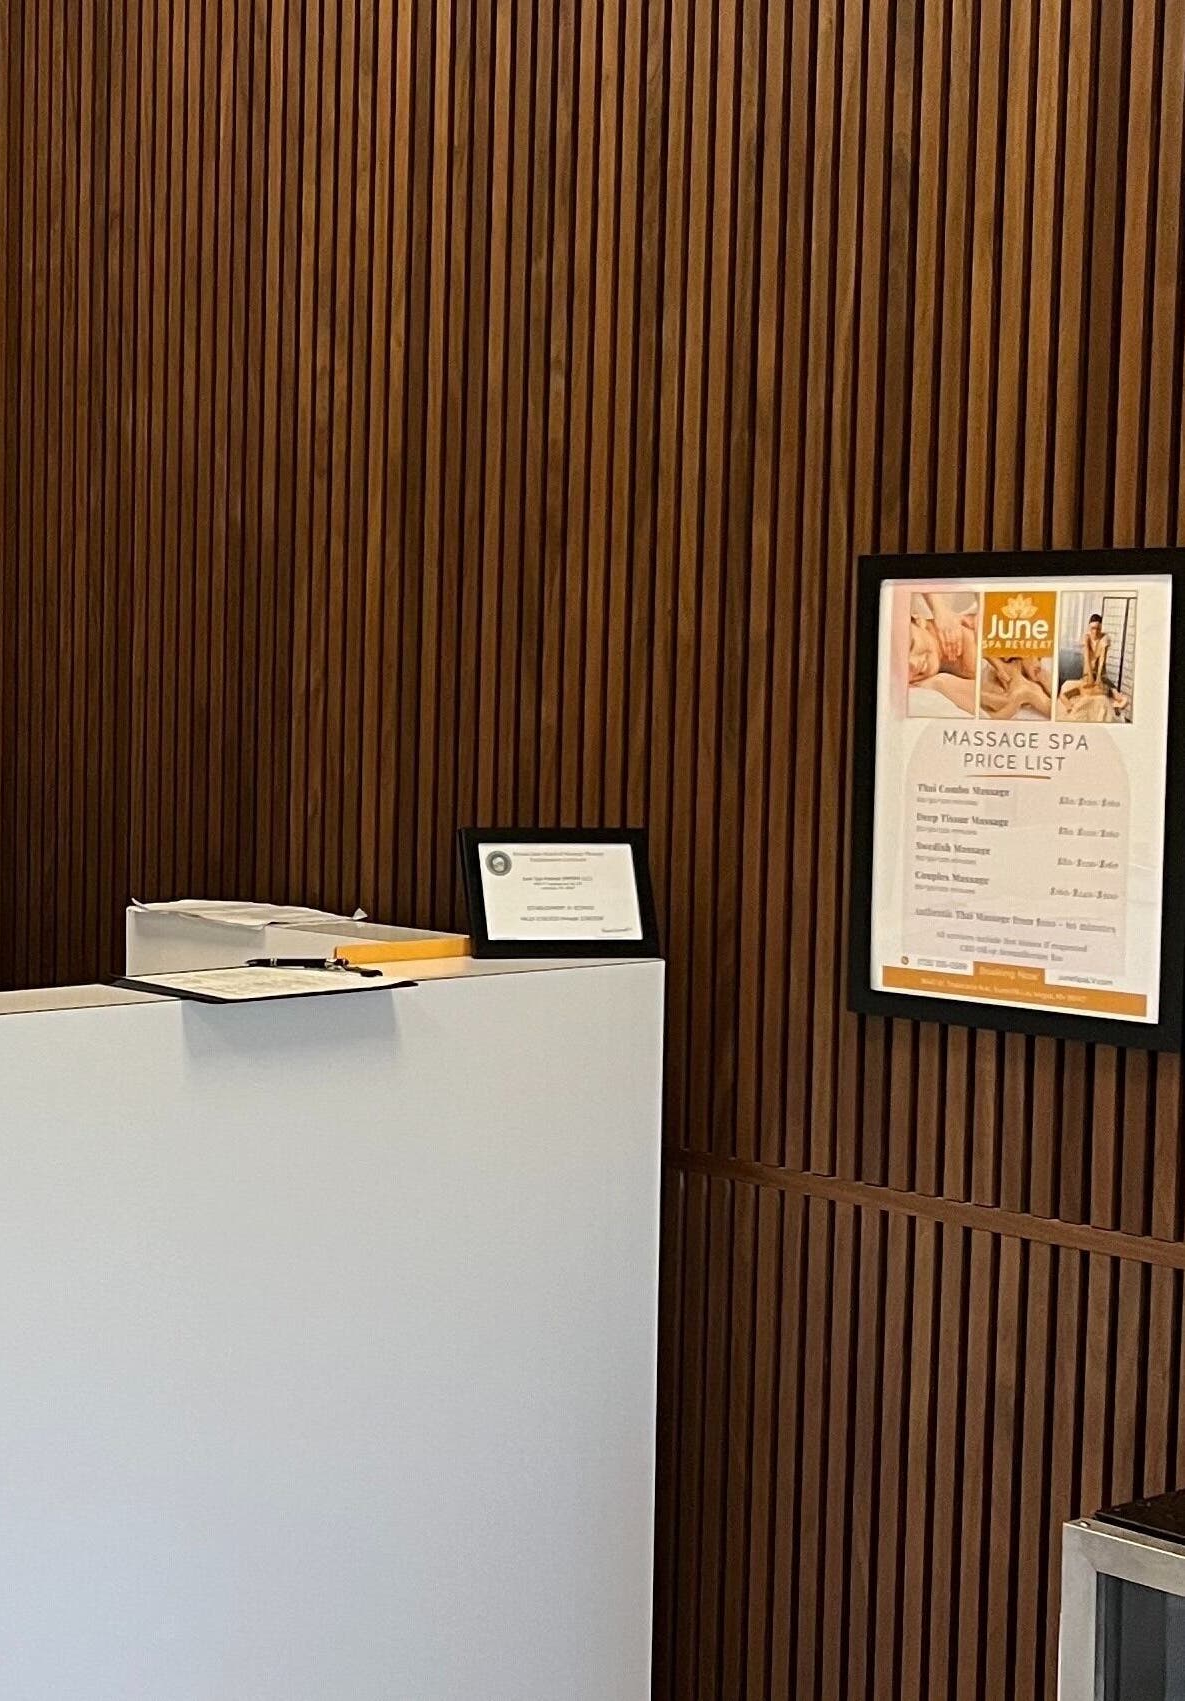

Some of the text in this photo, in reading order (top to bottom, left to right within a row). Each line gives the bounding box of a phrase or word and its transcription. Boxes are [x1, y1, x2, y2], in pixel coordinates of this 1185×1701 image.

[987, 613, 1049, 640] June
[982, 639, 1002, 649] SPA
[942, 729, 1089, 751] MASSAGE SPA
[962, 752, 1066, 772] PRICE LIST
